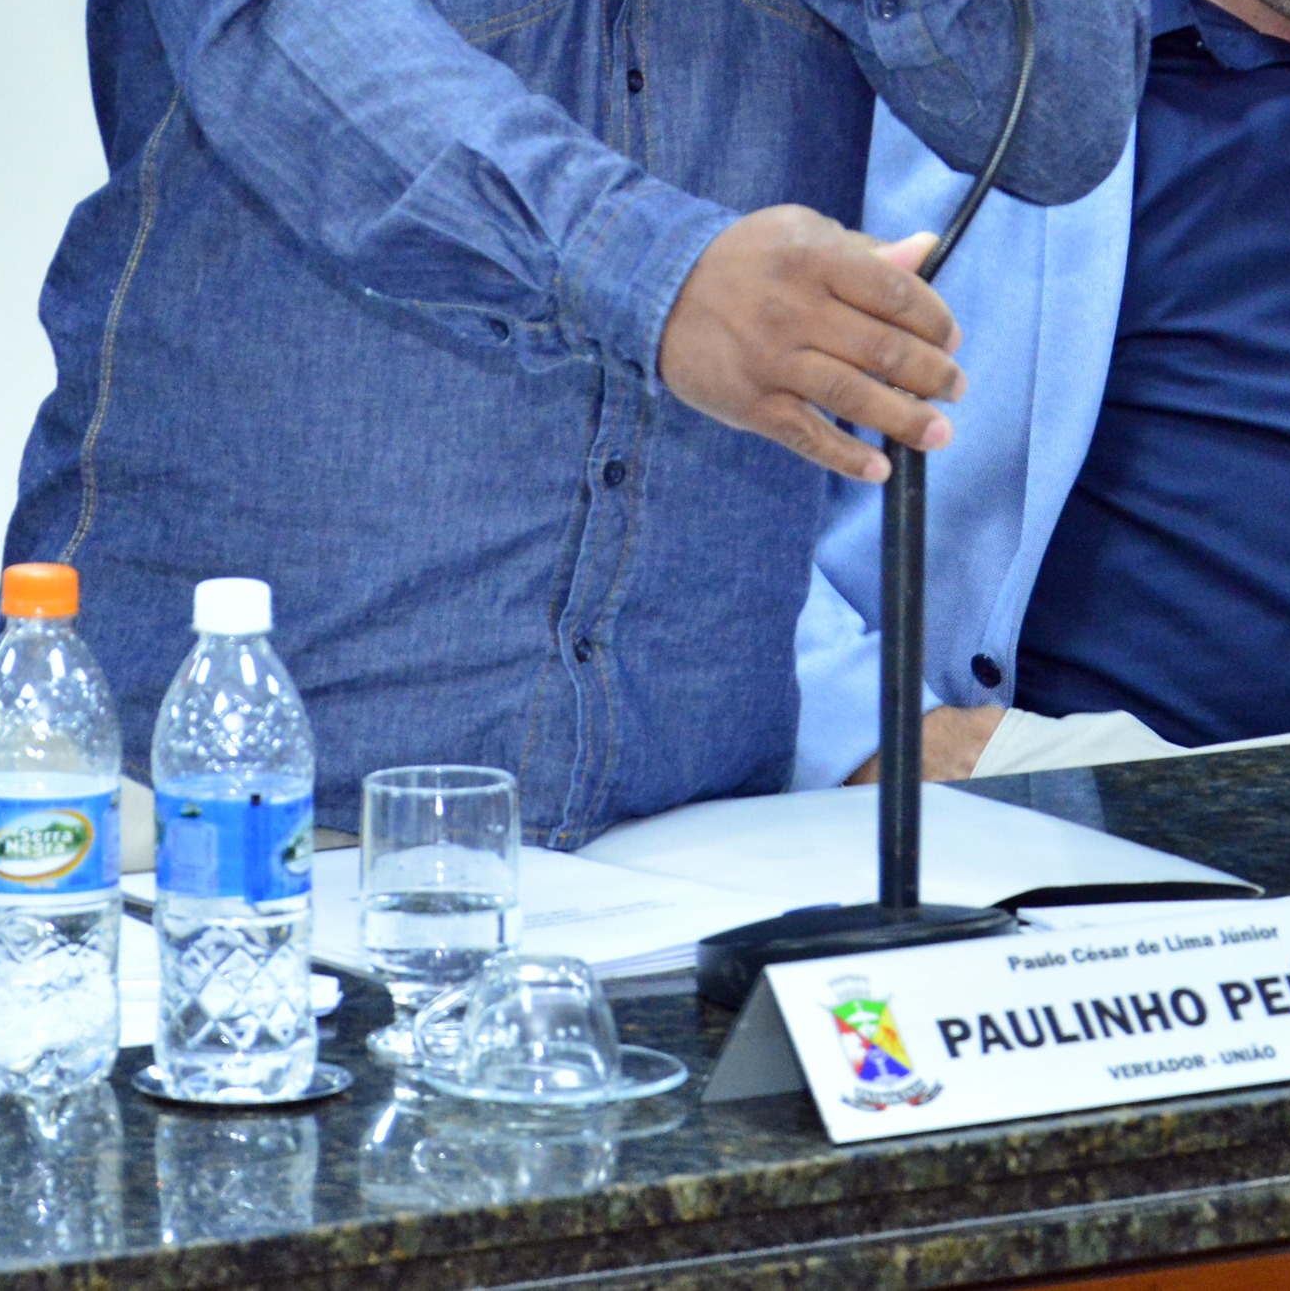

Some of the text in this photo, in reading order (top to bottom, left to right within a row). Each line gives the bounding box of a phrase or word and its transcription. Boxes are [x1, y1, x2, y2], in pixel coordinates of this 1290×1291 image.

[5, 840, 66, 856] Negra
[19, 827, 74, 843] Serra
[1007, 925, 1279, 972] Paulo César de Lima Júnior
[937, 987, 1209, 1058] PAULINHO
[1106, 1053, 1207, 1081] VEREADOR
[1220, 1045, 1277, 1067] UNIÃO
